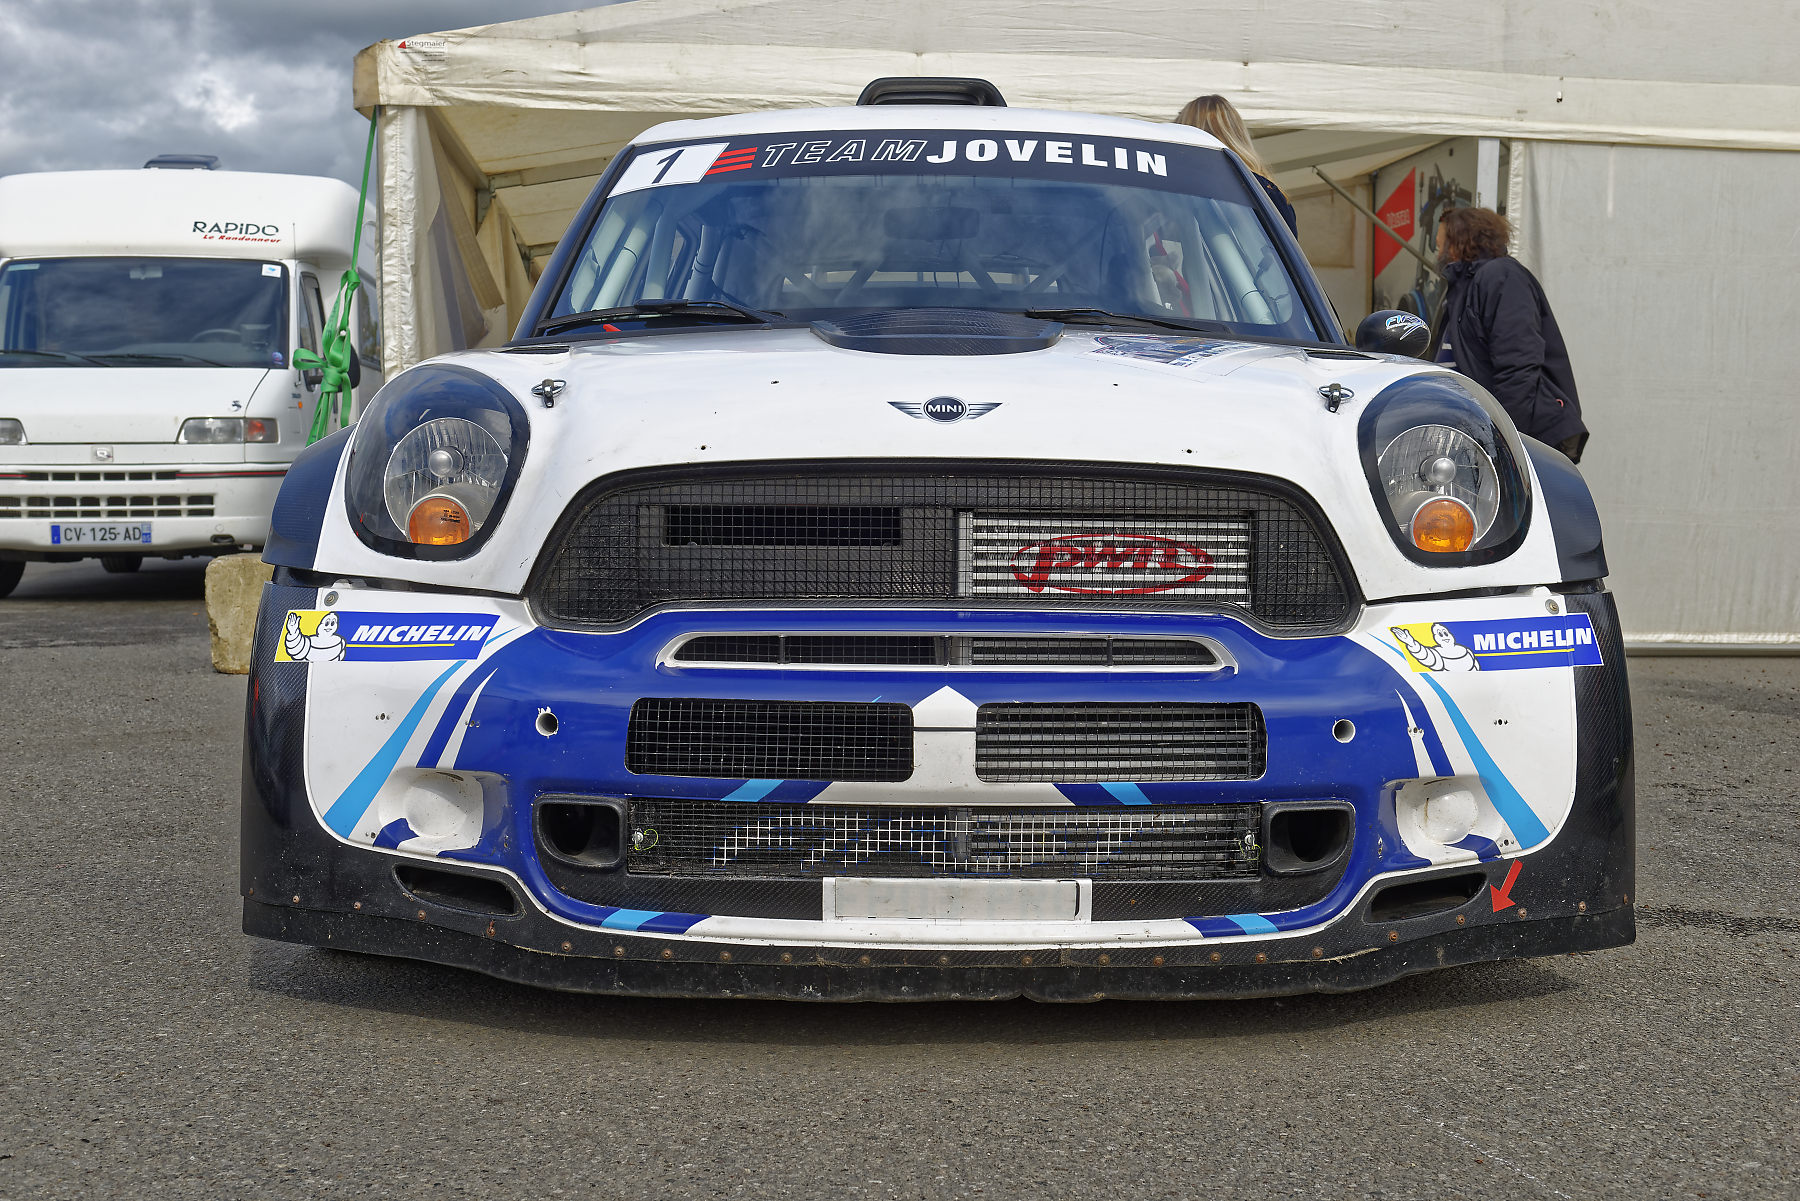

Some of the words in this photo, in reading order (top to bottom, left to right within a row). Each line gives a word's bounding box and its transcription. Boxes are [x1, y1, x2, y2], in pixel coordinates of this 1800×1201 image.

[650, 149, 686, 184] 1
[761, 139, 928, 168] TEAM
[926, 139, 1168, 177] JOVELIN
[927, 404, 963, 413] MINI
[350, 625, 492, 642] MICHELIN
[1473, 628, 1592, 650] MICHELIN
